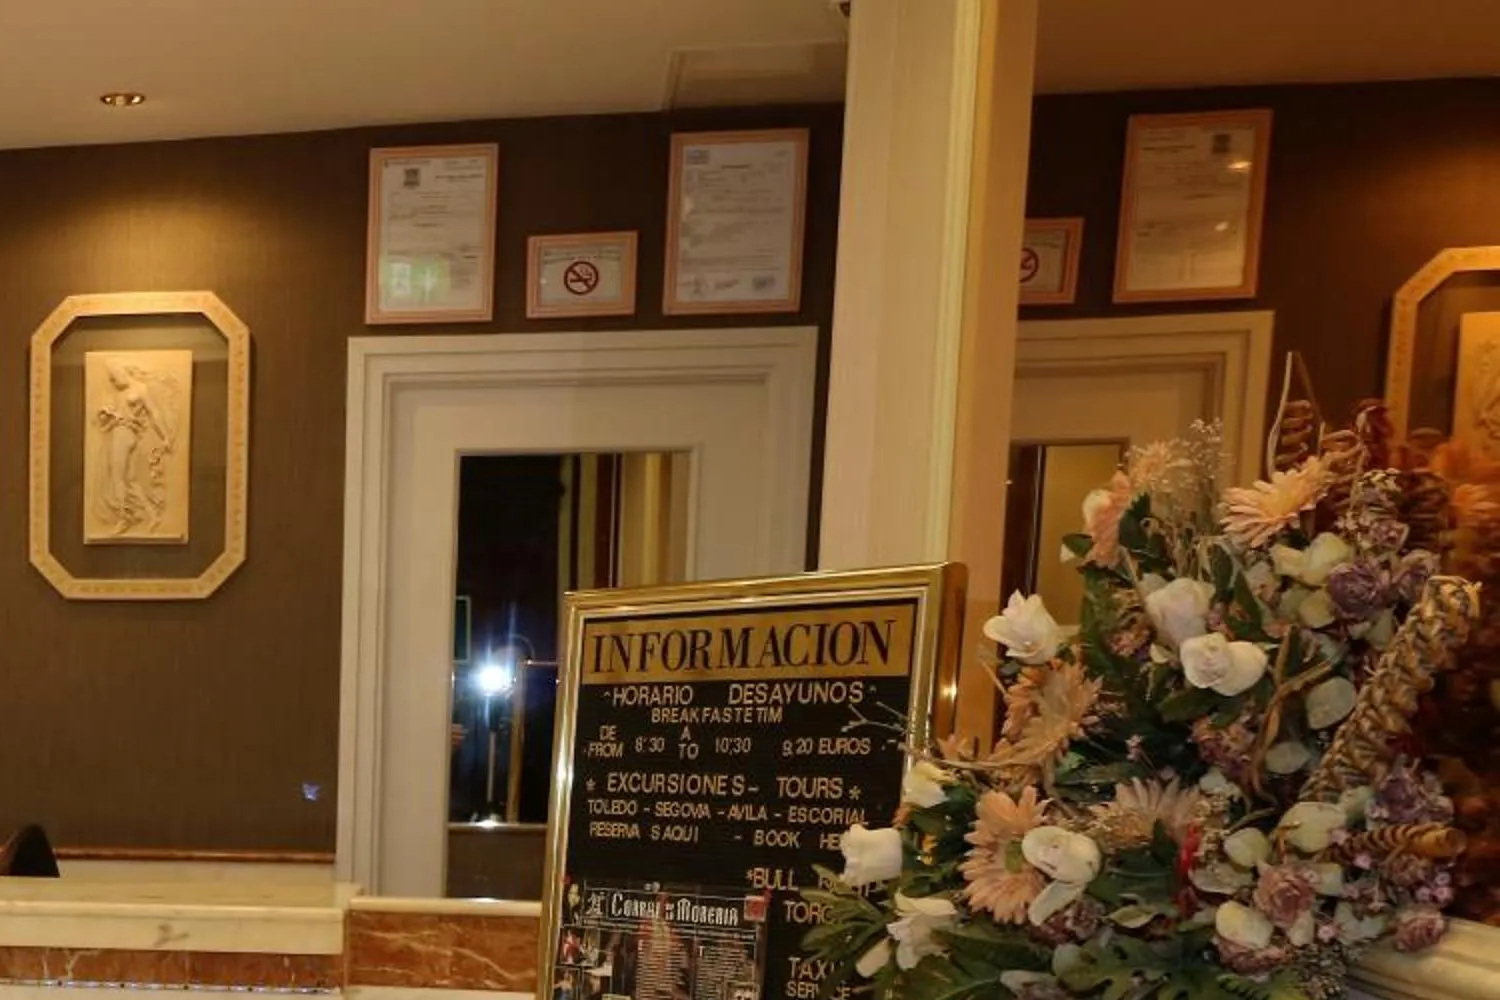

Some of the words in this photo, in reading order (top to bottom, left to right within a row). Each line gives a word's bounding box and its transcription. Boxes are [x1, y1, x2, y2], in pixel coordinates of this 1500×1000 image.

[592, 620, 897, 673] INFORMACION
[612, 684, 694, 706] HORARIO
[727, 681, 864, 705] DESAYUNOS
[600, 725, 617, 741] DE
[680, 725, 691, 741] A
[588, 741, 624, 758] FROM
[678, 743, 700, 760] TO
[818, 738, 872, 755] EUROS
[776, 776, 844, 799] TOURS
[588, 799, 638, 816] TOLEDO
[655, 801, 711, 819] SEGOVIA
[727, 803, 768, 821] AVILA
[788, 806, 869, 826] ESCORIAL
[753, 829, 800, 848] BOOK
[753, 868, 799, 891] BULL
